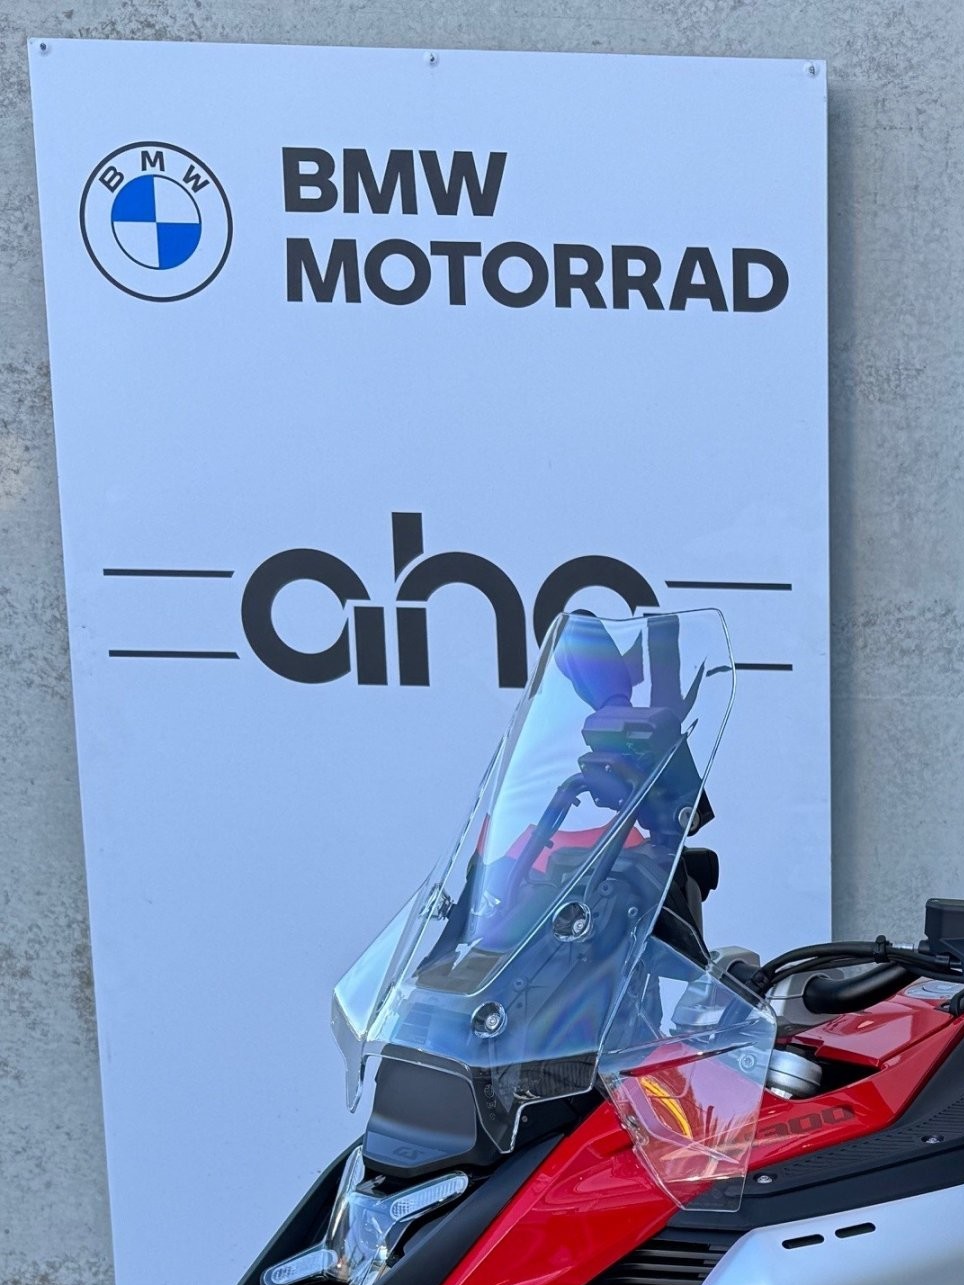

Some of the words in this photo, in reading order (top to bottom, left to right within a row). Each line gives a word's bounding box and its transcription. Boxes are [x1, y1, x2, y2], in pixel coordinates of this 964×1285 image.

[98, 150, 210, 193] BMW
[281, 147, 508, 216] BMW
[285, 238, 790, 313] MOTORRAD
